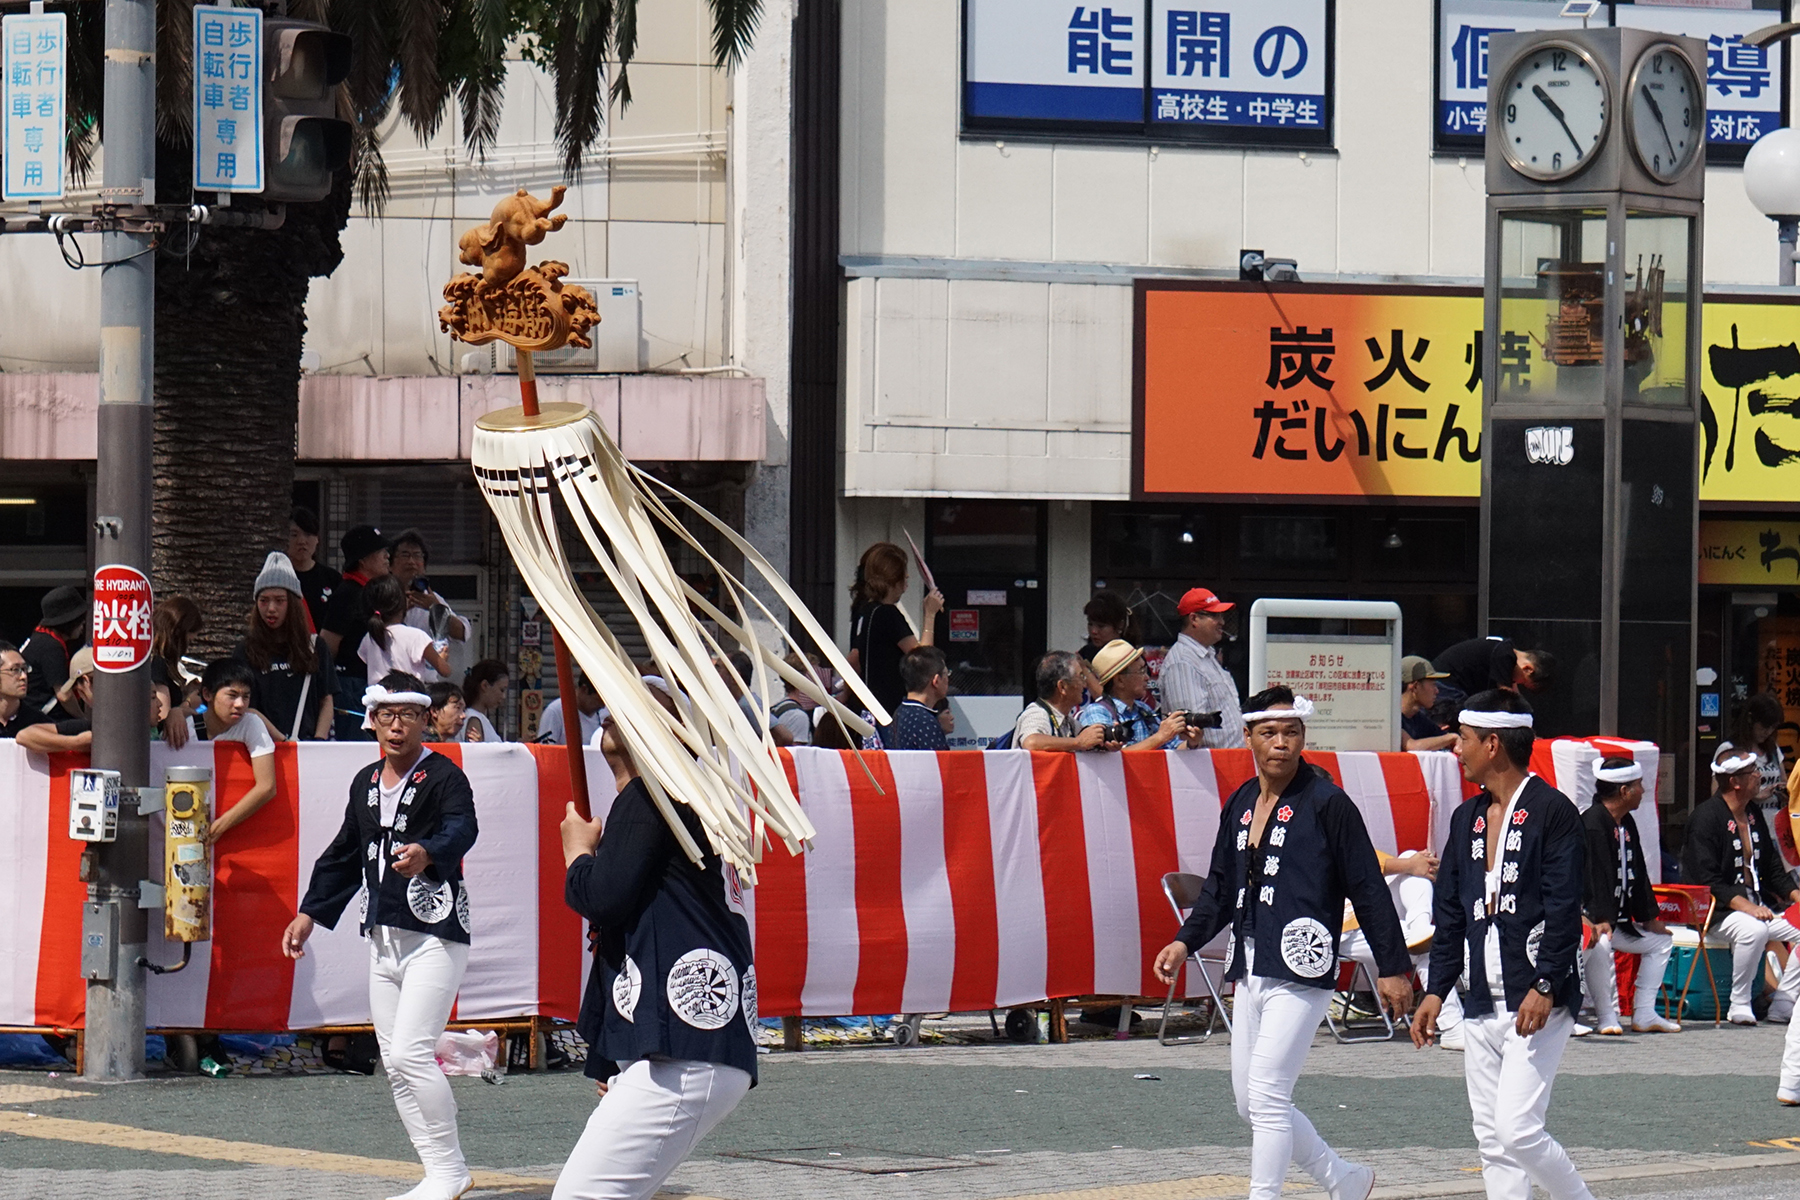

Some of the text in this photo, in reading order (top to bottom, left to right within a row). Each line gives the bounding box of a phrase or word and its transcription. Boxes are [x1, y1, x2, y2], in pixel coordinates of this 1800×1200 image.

[1068, 7, 1308, 79] 能開の
[12, 30, 32, 119] 自転車
[36, 28, 57, 118] 歩行者
[203, 20, 225, 110] 自転車
[228, 21, 253, 112] 歩行者
[1552, 53, 1566, 71] 12
[1653, 55, 1663, 74] 12
[1157, 93, 1318, 124] 高校生・中学生
[1507, 104, 1517, 123] 9
[1683, 108, 1690, 127] 3
[1710, 114, 1761, 141] 対応
[23, 125, 43, 187] 専用
[216, 118, 237, 179] 専用
[1552, 153, 1561, 171] 6
[1654, 155, 1660, 173] 6
[1266, 326, 1531, 395] 炭火焼
[106, 579, 146, 591] HYDRANT
[94, 599, 151, 640] 消火栓
[1309, 654, 1344, 667] お知らせ
